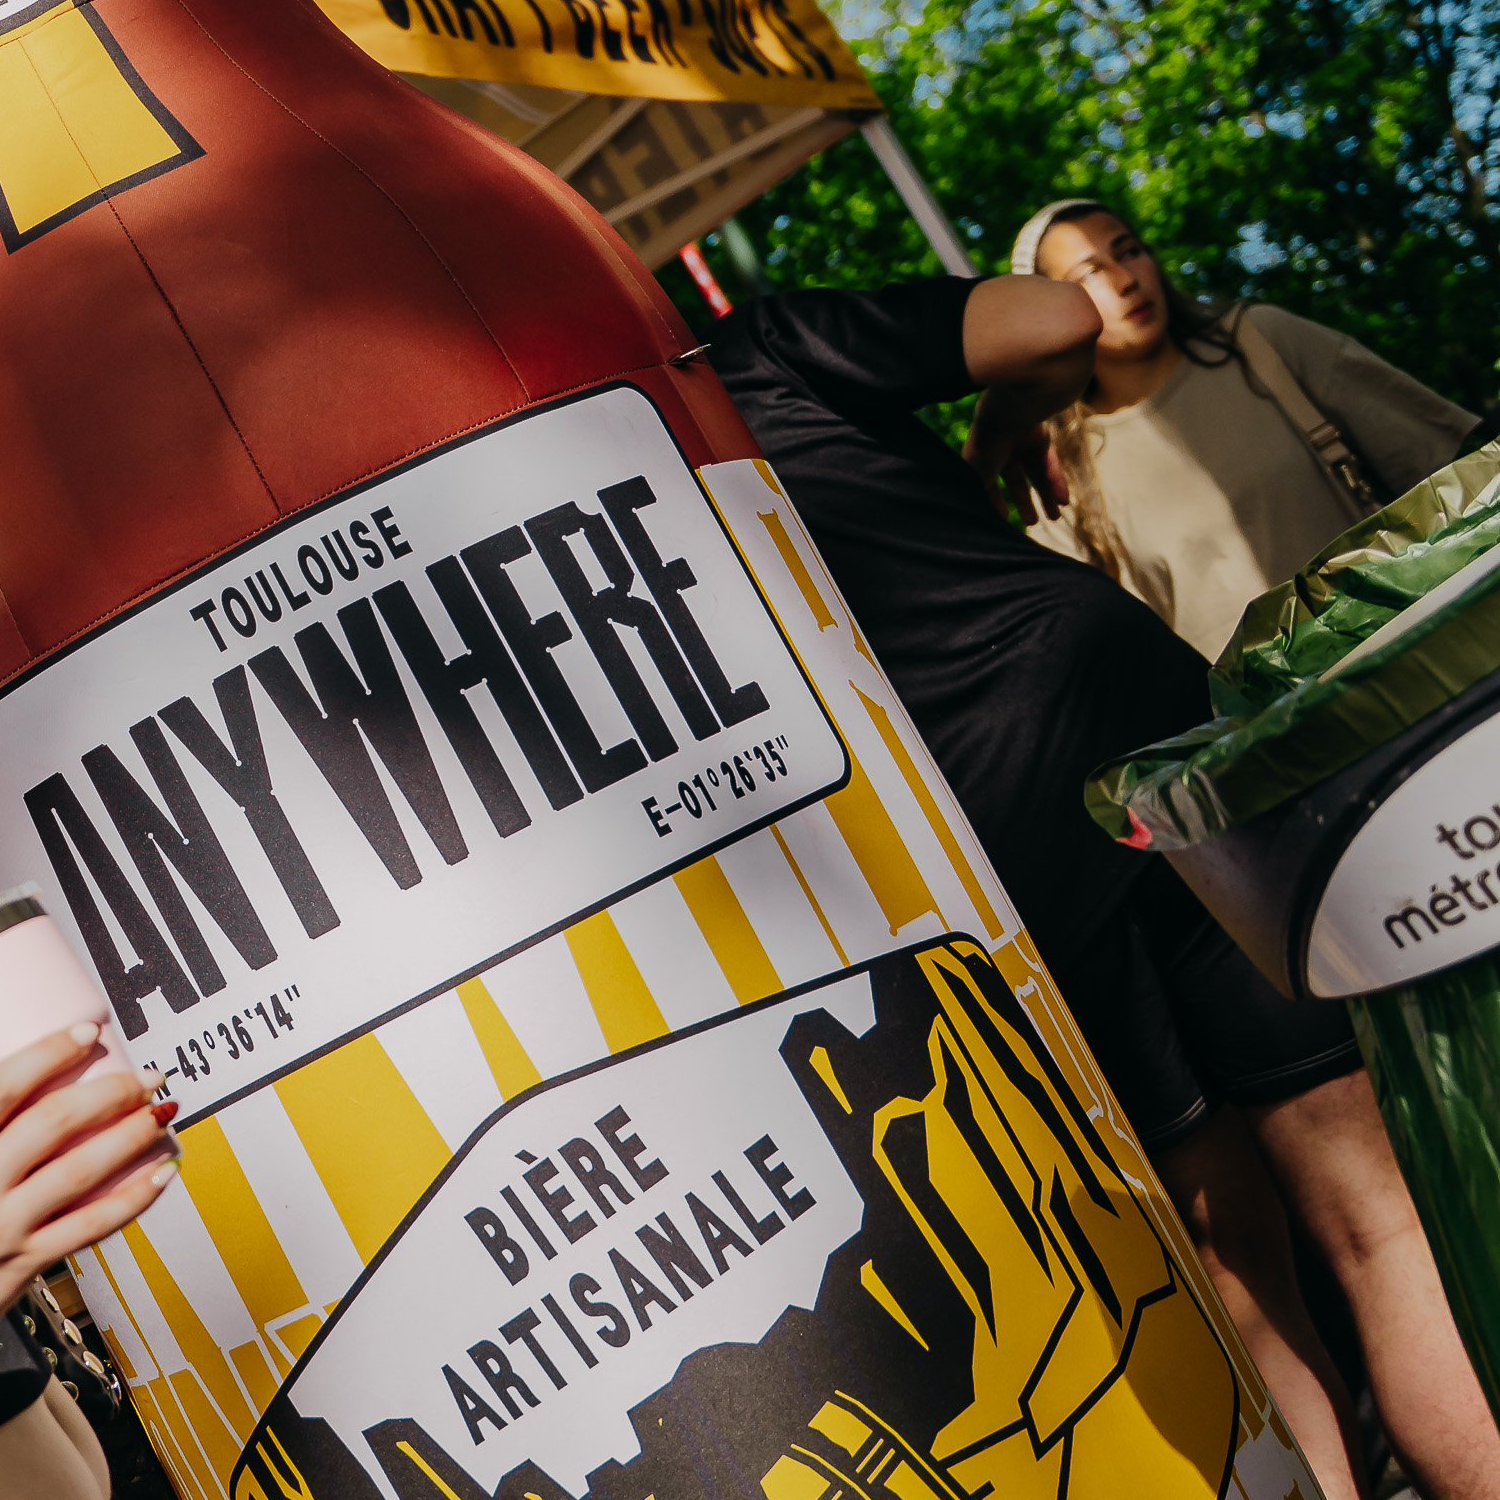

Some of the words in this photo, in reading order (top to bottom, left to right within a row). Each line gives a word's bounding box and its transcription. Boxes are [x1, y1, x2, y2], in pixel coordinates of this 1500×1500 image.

[189, 506, 413, 652] TOULOUSE
[23, 474, 770, 1041] ANYWHERE
[441, 1133, 817, 1446] ARTISANALE
[464, 1104, 670, 1287] BIÈRE
